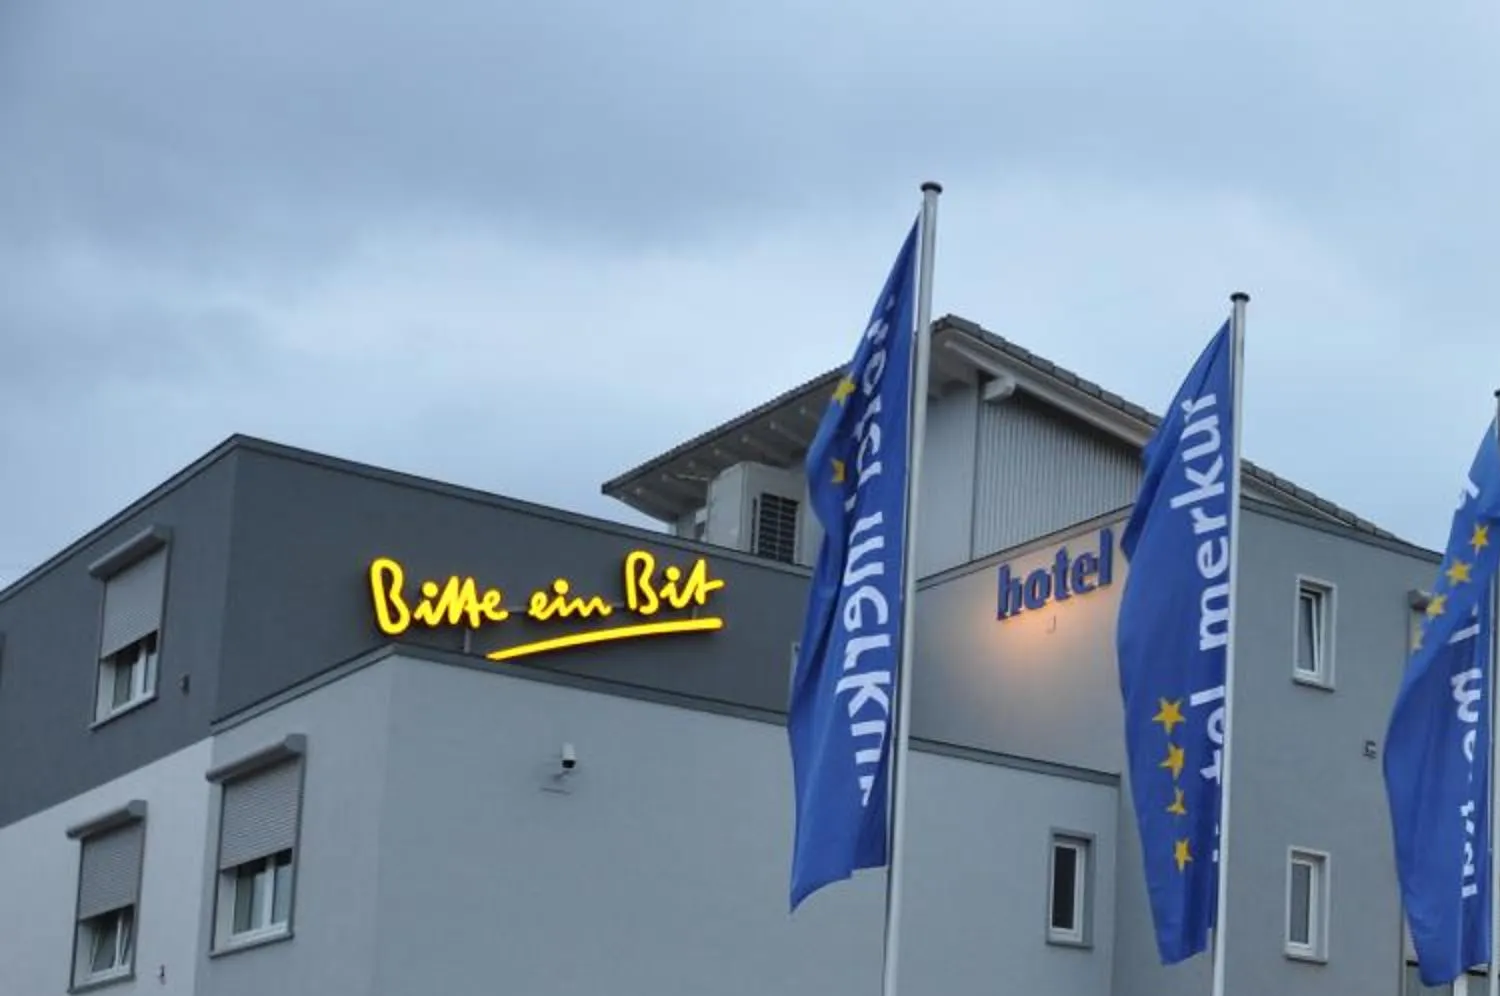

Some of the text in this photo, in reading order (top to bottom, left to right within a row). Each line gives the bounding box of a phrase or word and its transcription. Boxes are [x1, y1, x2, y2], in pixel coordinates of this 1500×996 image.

[1169, 392, 1231, 652] merkur
[369, 550, 725, 636] Bitte ein Bit
[996, 528, 1113, 621] hotel
